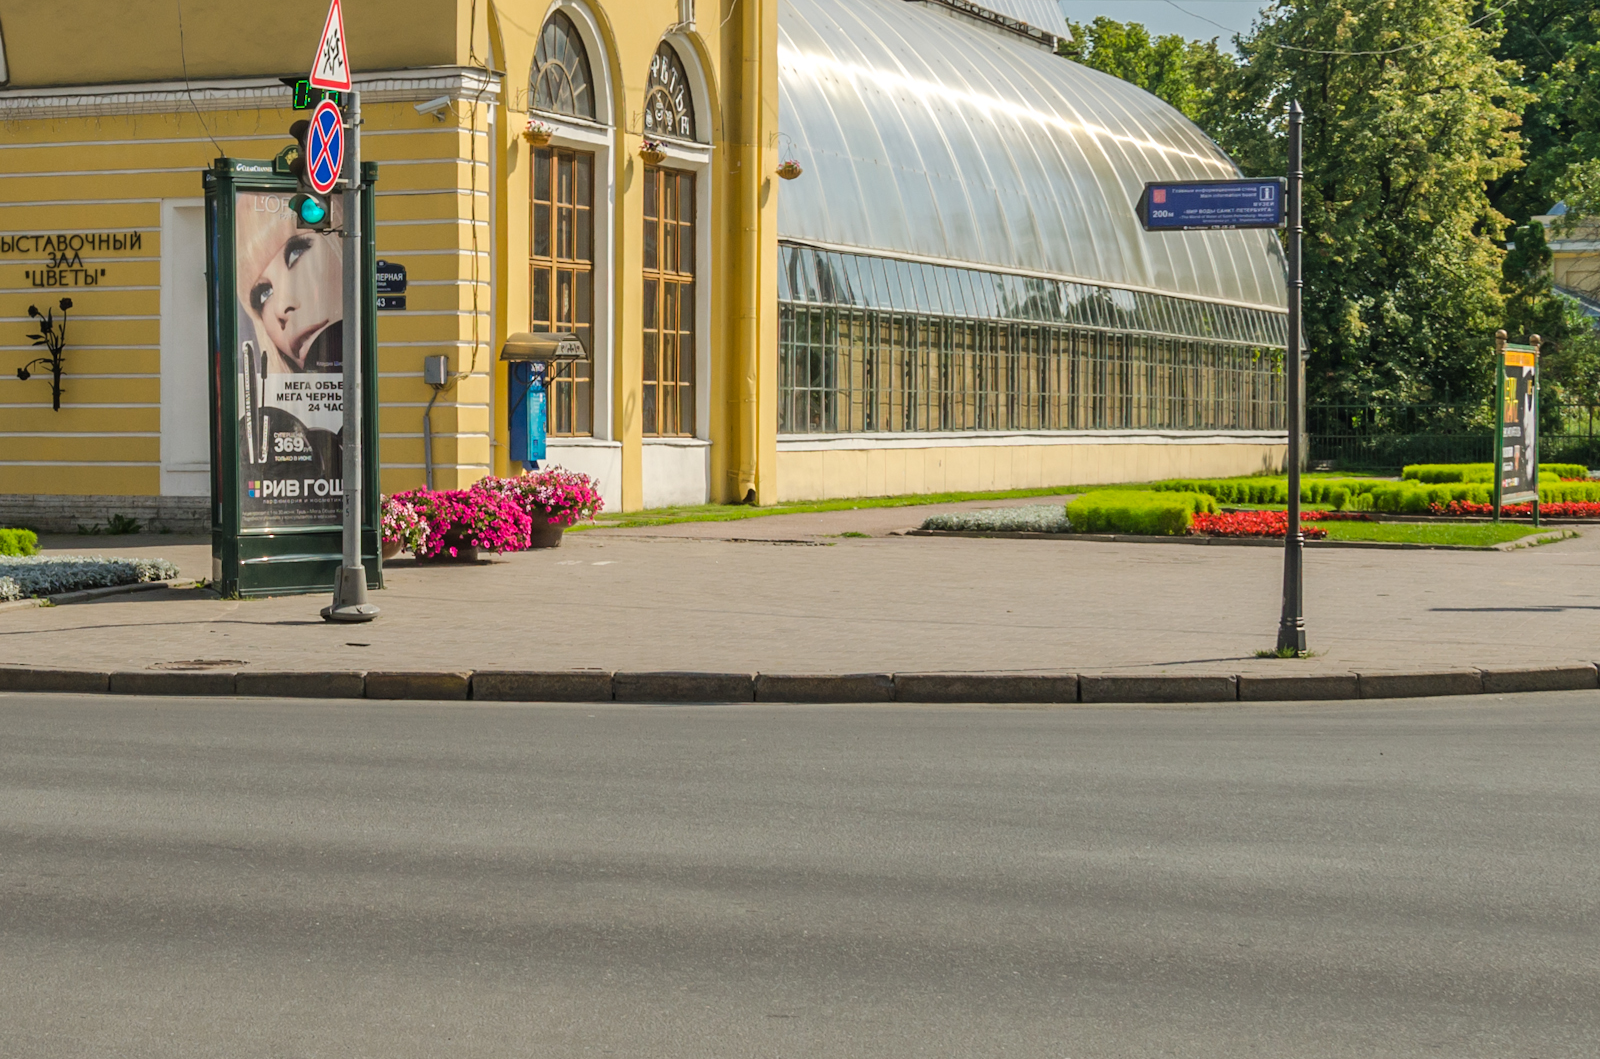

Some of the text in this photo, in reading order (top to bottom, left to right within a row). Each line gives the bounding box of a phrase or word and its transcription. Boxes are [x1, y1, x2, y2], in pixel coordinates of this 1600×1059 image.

[46, 252, 84, 269] ЗАЛ
[284, 381, 343, 390] МЕГА ОБЪЕ
[276, 393, 303, 401] МЕГА
[308, 403, 343, 412] 24 ЧАС
[274, 437, 304, 453] 369
[262, 478, 343, 497] РИВ ГОШ
